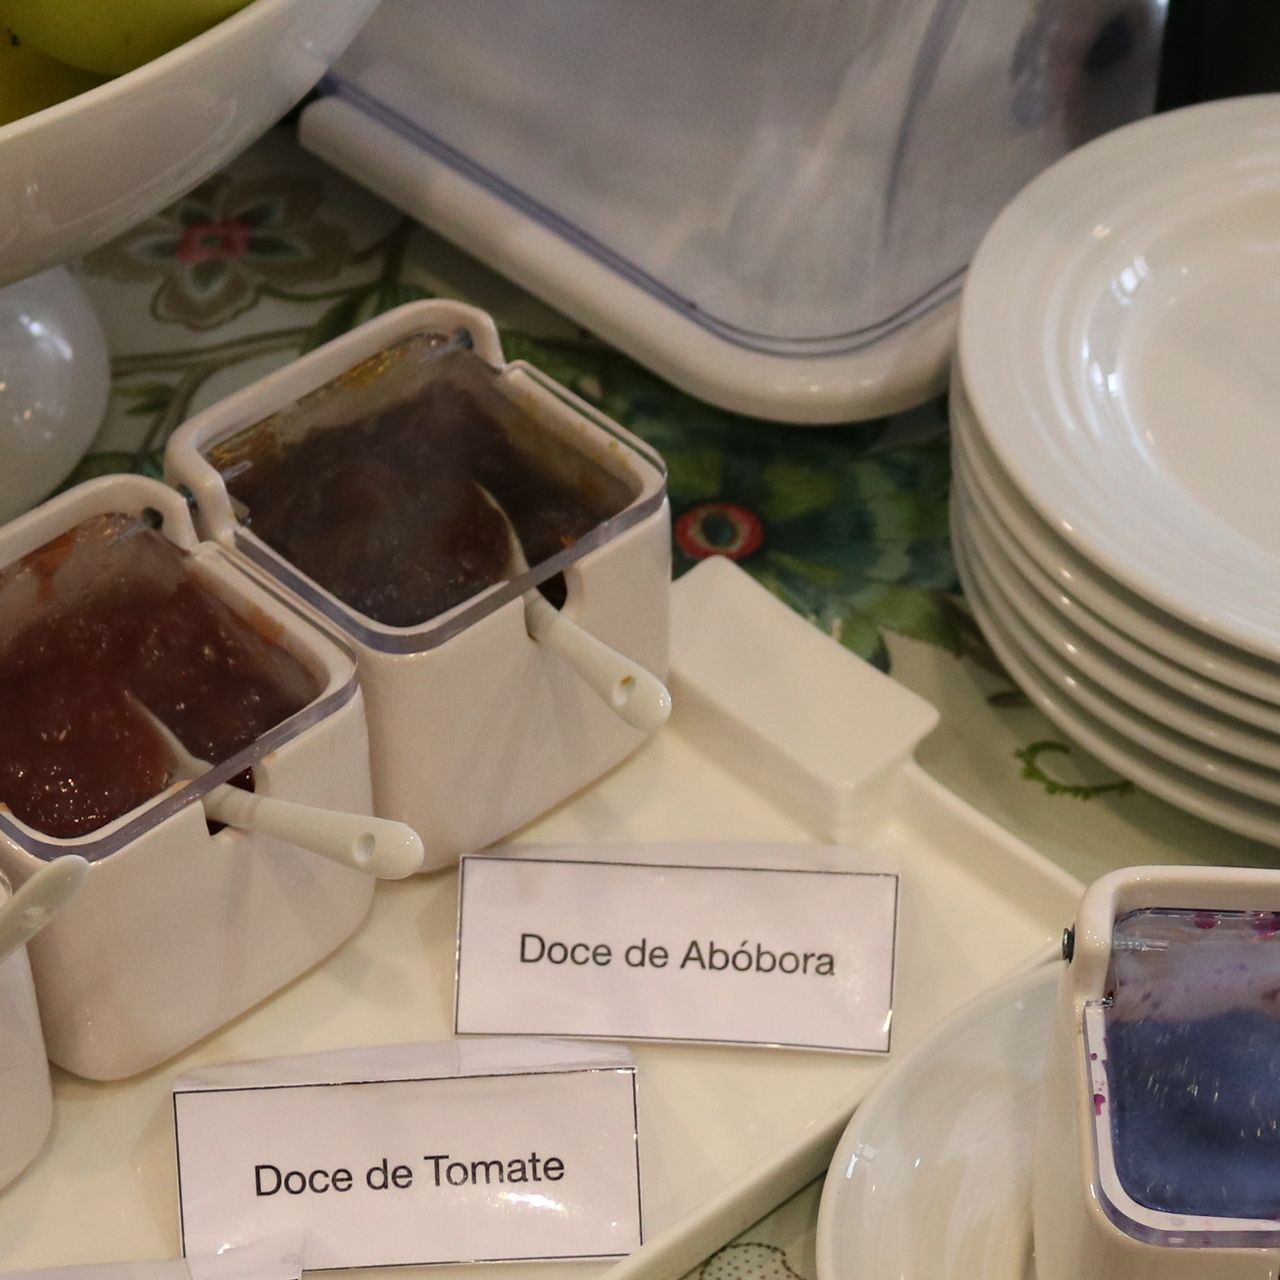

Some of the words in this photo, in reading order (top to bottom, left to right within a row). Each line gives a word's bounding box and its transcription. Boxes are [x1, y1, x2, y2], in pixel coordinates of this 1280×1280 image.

[520, 932, 613, 969] Doce
[624, 935, 671, 970] de
[680, 938, 836, 977] Abóbora
[254, 1161, 354, 1198] Doce
[365, 1156, 414, 1191] de
[424, 1148, 566, 1188] Tomate
